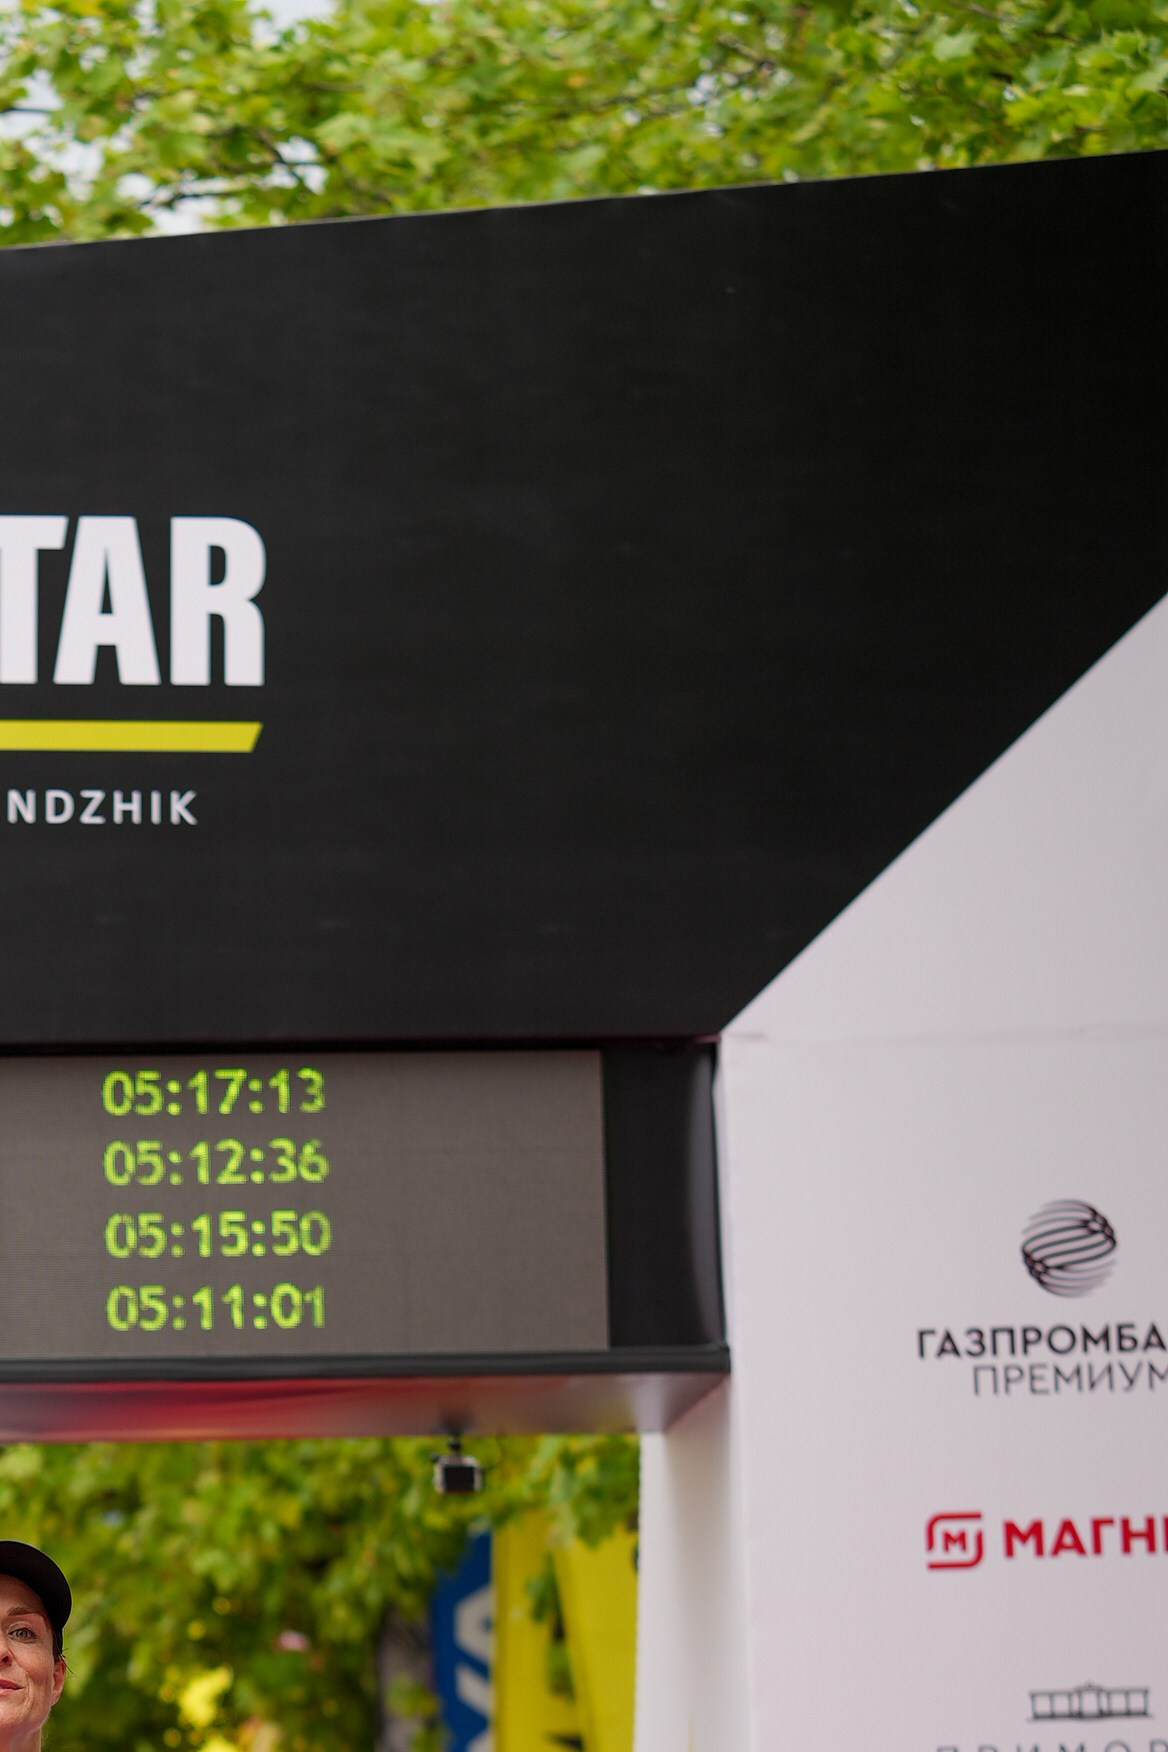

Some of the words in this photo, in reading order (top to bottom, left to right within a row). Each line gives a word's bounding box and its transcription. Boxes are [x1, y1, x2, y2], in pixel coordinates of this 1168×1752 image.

[101, 1067, 325, 1116] 05:17:13
[103, 1137, 329, 1185] 05:12:36
[104, 1209, 332, 1257] 05:15:50
[105, 1282, 325, 1330] 05:11:01
[918, 1321, 1168, 1359] ГАЗПРОМБА
[1003, 1515, 1168, 1558] МАГН
